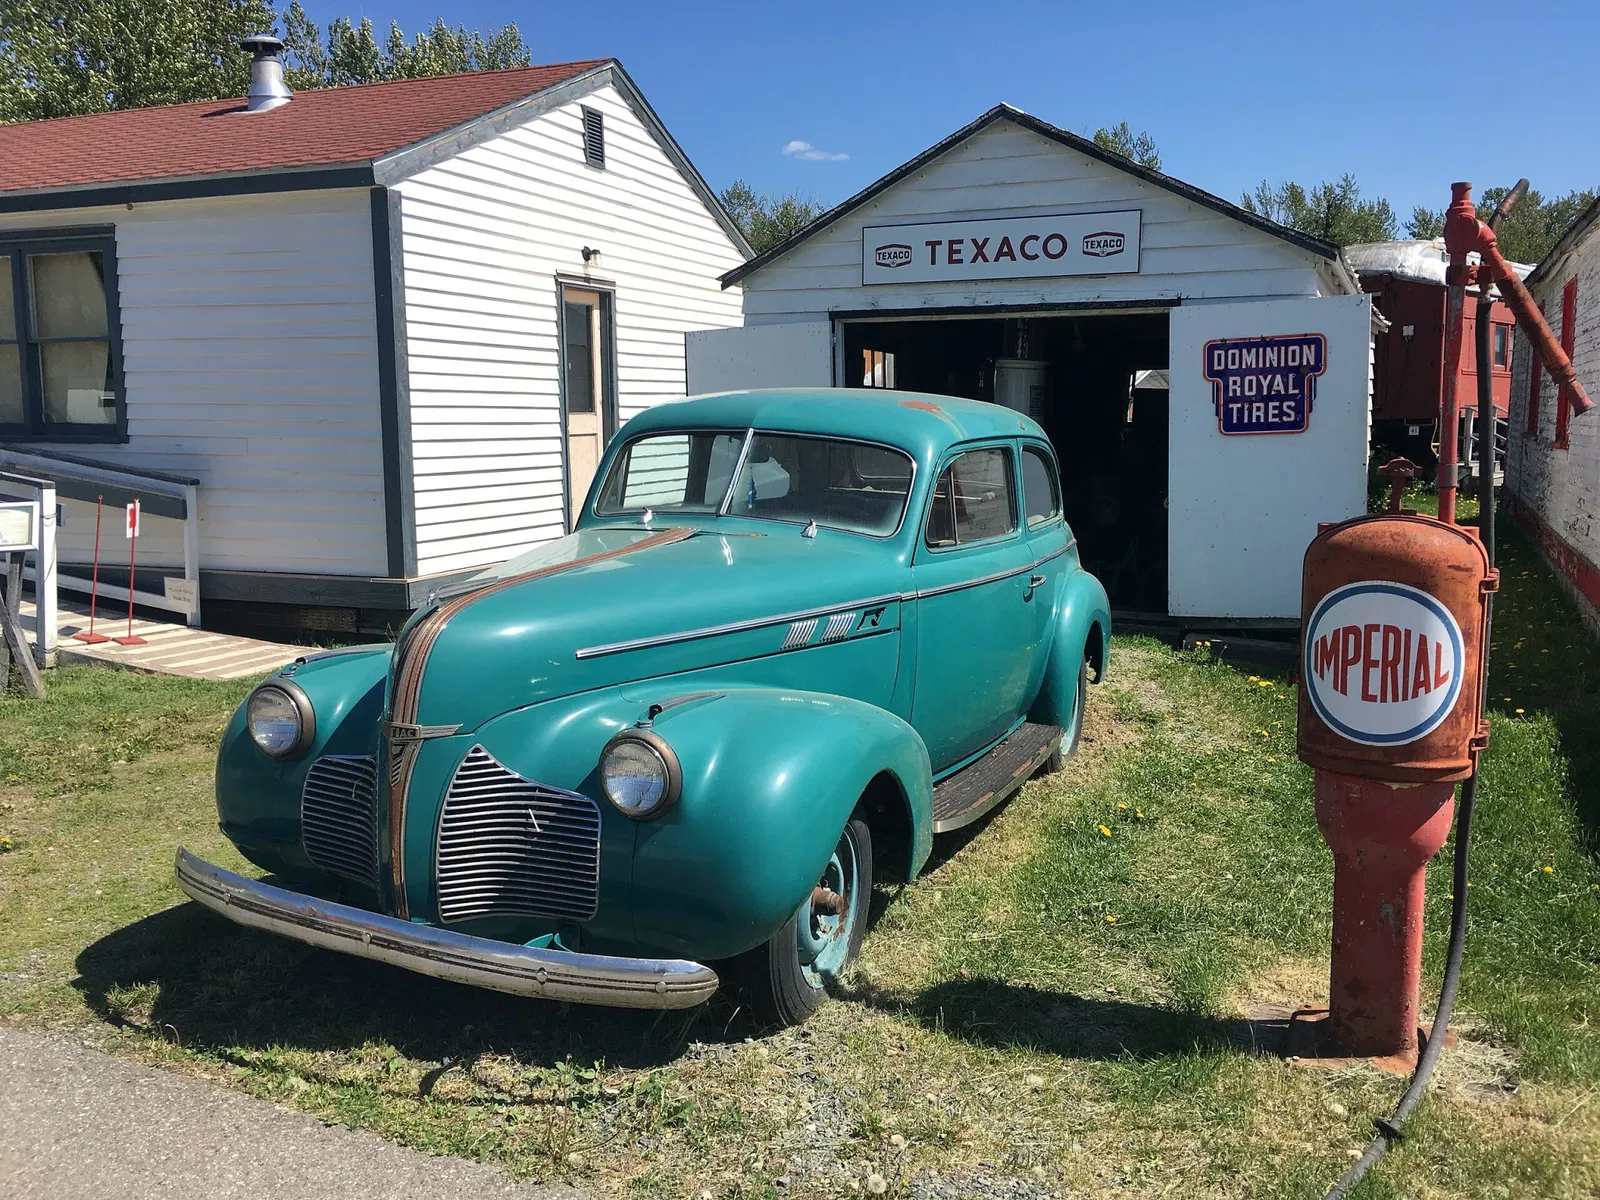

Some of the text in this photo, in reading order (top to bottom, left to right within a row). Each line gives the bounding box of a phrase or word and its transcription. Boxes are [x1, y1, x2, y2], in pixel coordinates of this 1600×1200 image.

[877, 250, 910, 261] TEXACO
[925, 233, 1068, 266] TEXACO
[1084, 238, 1123, 250] TEXACO
[1213, 344, 1316, 371] DOMINION
[1228, 373, 1300, 397] ROYAL
[1228, 401, 1296, 424] TIRES
[1313, 623, 1450, 704] IMPERIAL
